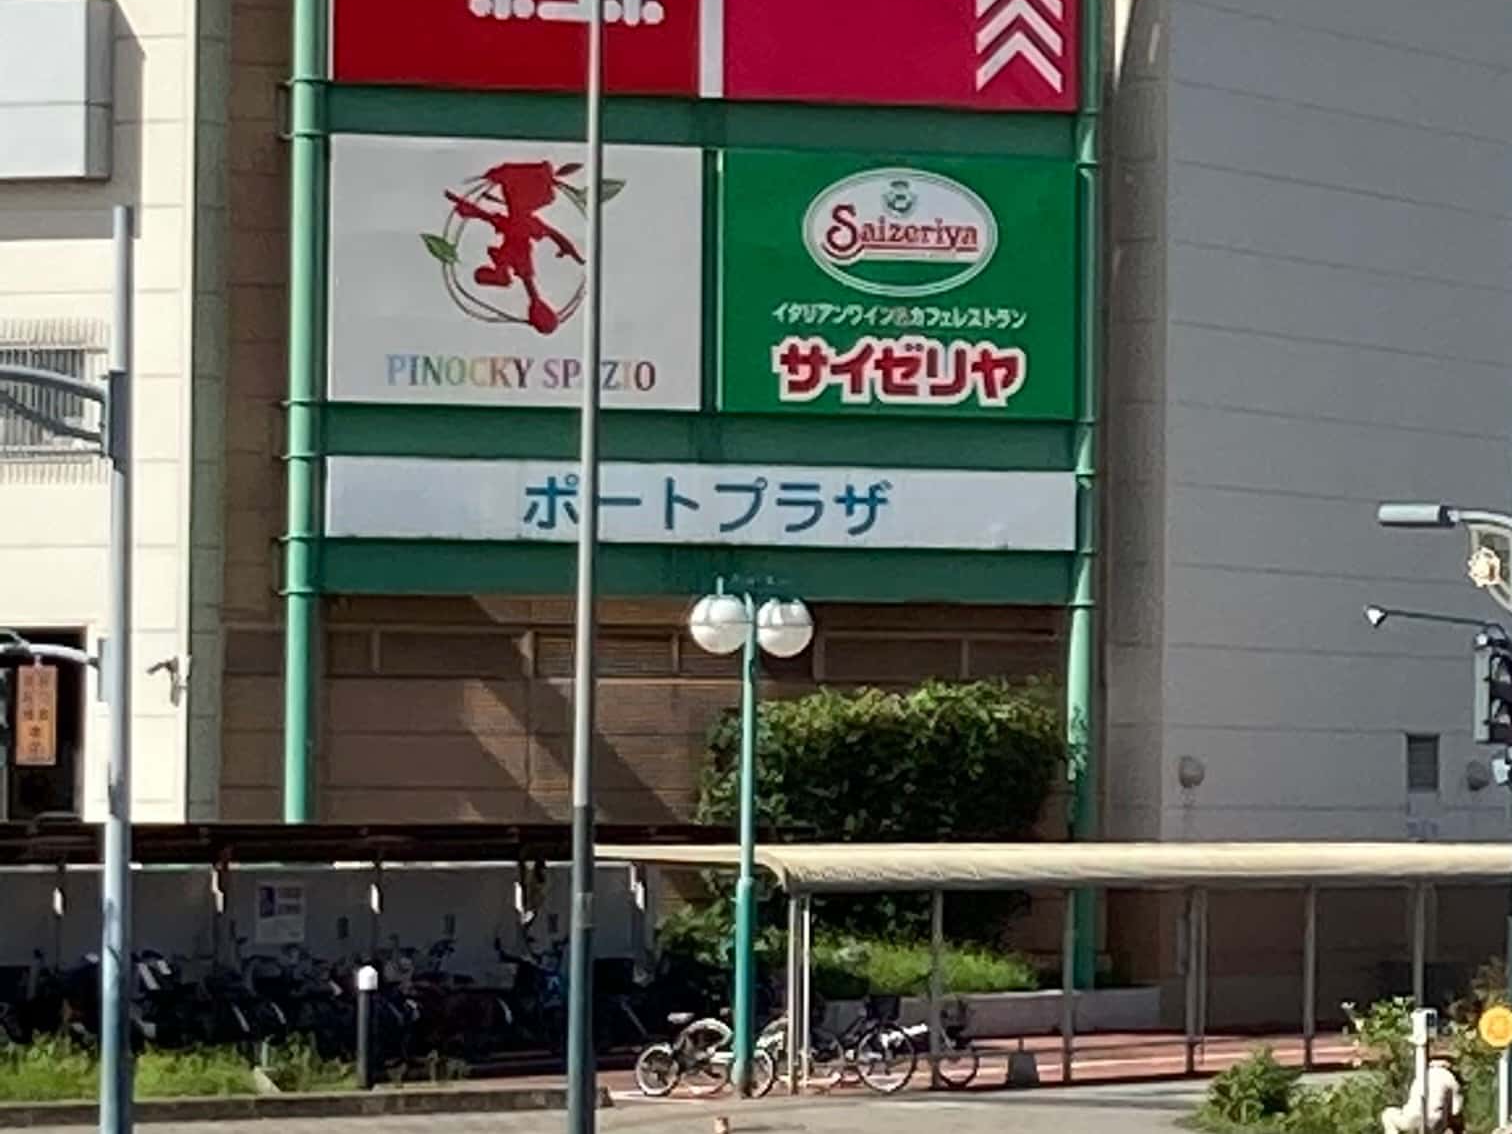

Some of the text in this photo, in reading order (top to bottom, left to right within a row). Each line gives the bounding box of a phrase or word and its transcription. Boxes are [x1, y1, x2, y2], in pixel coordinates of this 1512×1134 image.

[824, 203, 980, 255] Saizeriya
[385, 352, 657, 392] PINOCKY SPZIO
[775, 339, 1023, 403] サイゼリヤ
[523, 473, 893, 536] ポートプラザ
